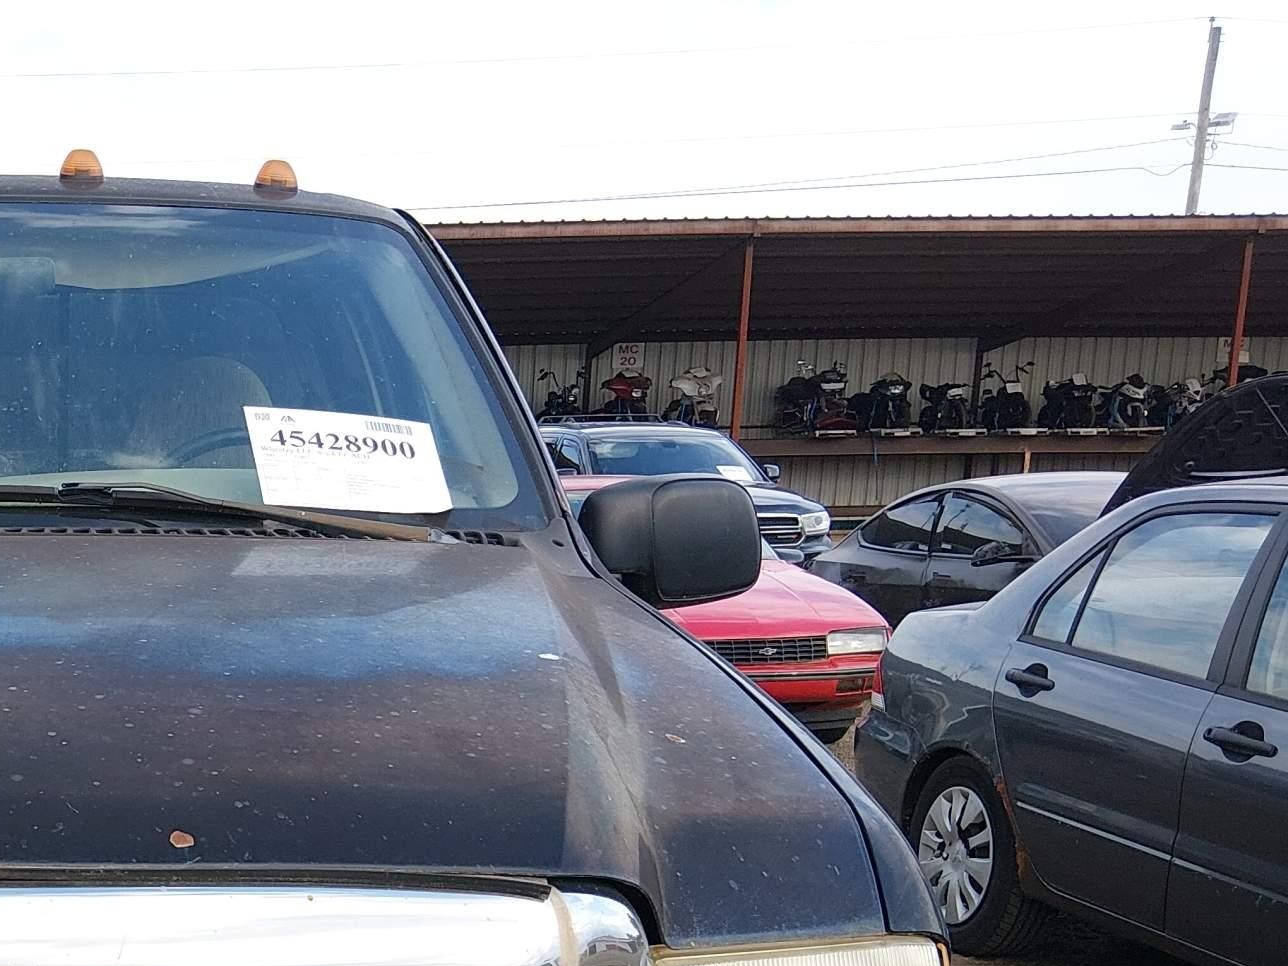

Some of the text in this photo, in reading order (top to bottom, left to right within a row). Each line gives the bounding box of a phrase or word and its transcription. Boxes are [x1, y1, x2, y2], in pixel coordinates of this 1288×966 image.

[618, 344, 639, 354] MC
[620, 356, 636, 366] 20
[270, 429, 415, 459] 45428900
